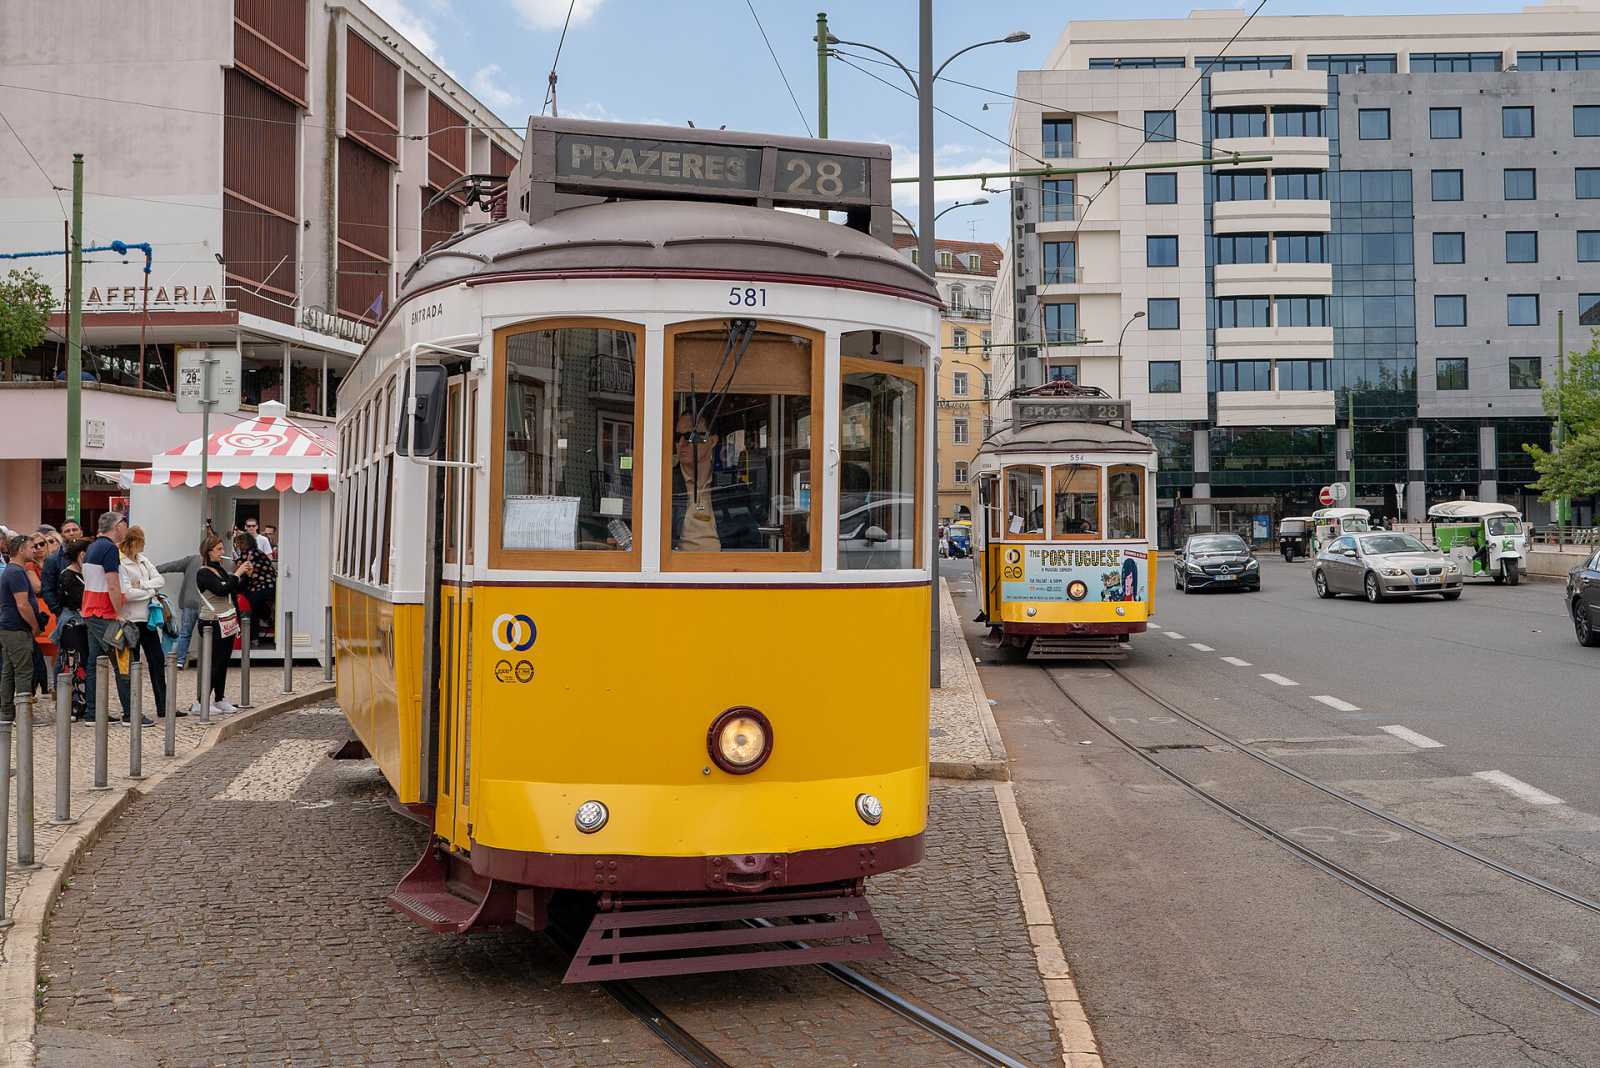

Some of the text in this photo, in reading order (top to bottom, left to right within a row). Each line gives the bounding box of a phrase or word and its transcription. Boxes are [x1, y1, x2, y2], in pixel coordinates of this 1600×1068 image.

[571, 143, 844, 197] PRAZERES 28
[1015, 188, 1026, 278] HOTEL
[85, 285, 217, 307] AFETARIA
[728, 286, 767, 307] 581
[411, 303, 443, 326] ENTRADA
[1098, 406, 1118, 418] 28
[1029, 549, 1040, 558] THE
[1041, 549, 1121, 567] PORTUGUESE
